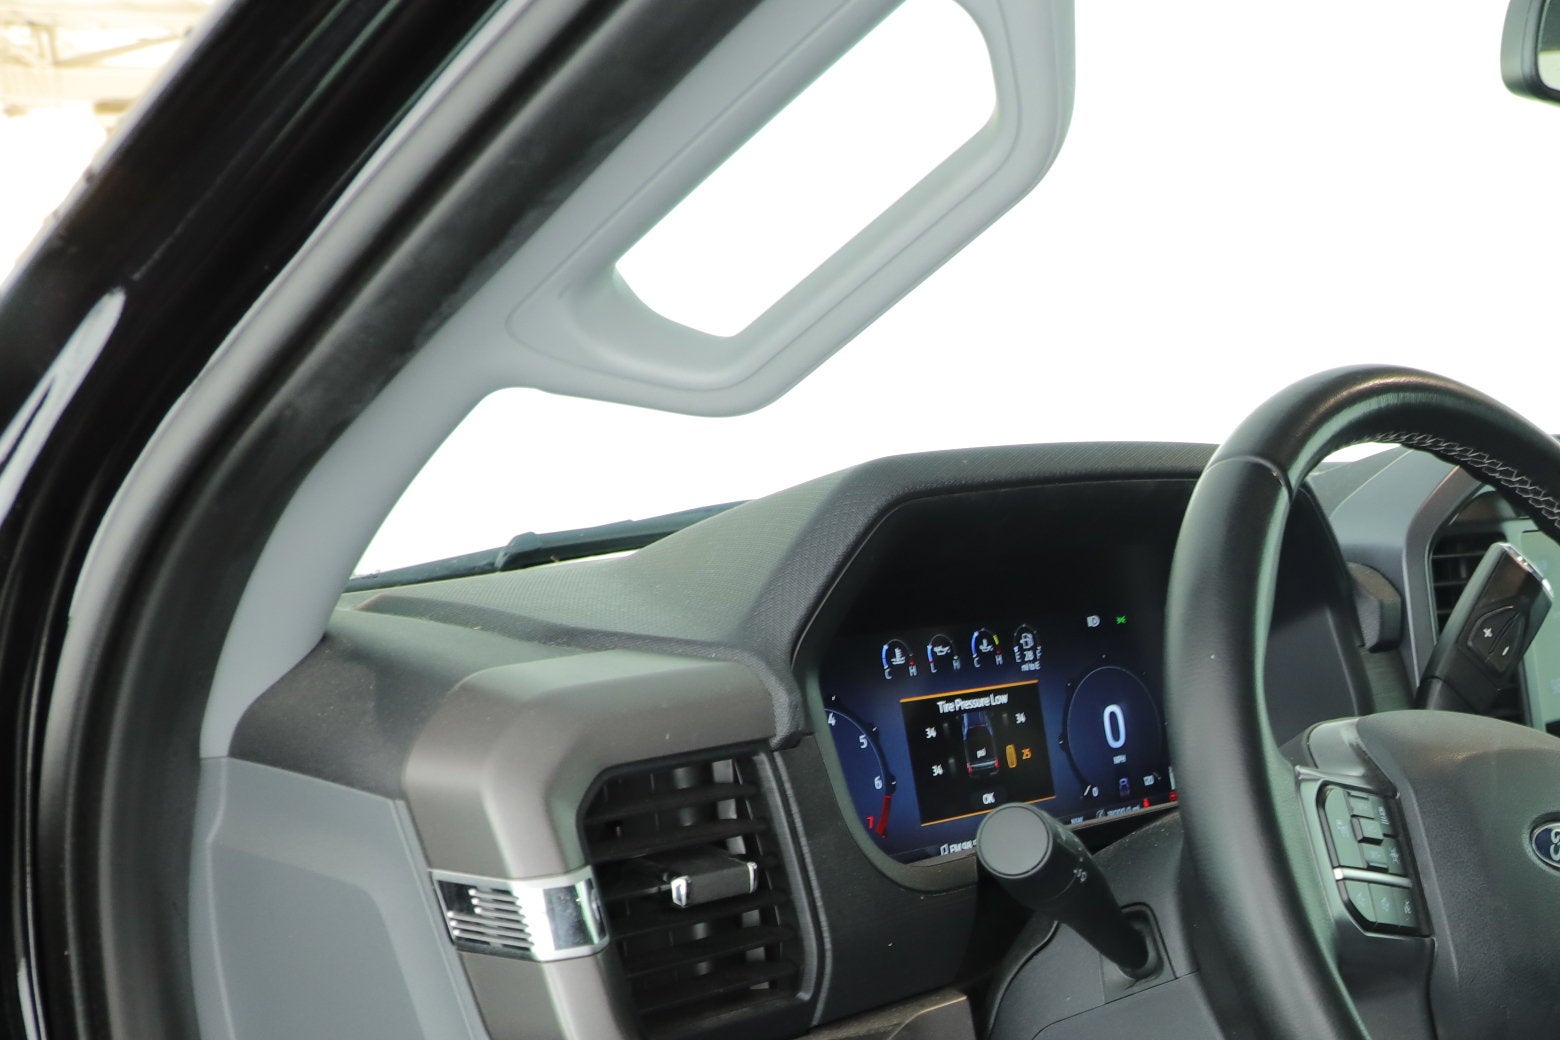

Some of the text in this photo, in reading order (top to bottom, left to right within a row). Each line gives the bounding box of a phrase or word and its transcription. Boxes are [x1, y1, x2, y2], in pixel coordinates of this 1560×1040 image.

[930, 662, 938, 673] L
[973, 654, 1003, 668] C H
[884, 665, 918, 680] C H
[936, 693, 1009, 714] Tire Pressure Low
[827, 712, 837, 727] 4
[1015, 712, 1027, 724] 34
[925, 726, 937, 739] 34
[1103, 704, 1126, 749] 0
[859, 734, 868, 749] 5
[931, 764, 944, 777] 34
[874, 775, 883, 790] 6
[982, 791, 996, 805] OK
[865, 815, 875, 830] 7
